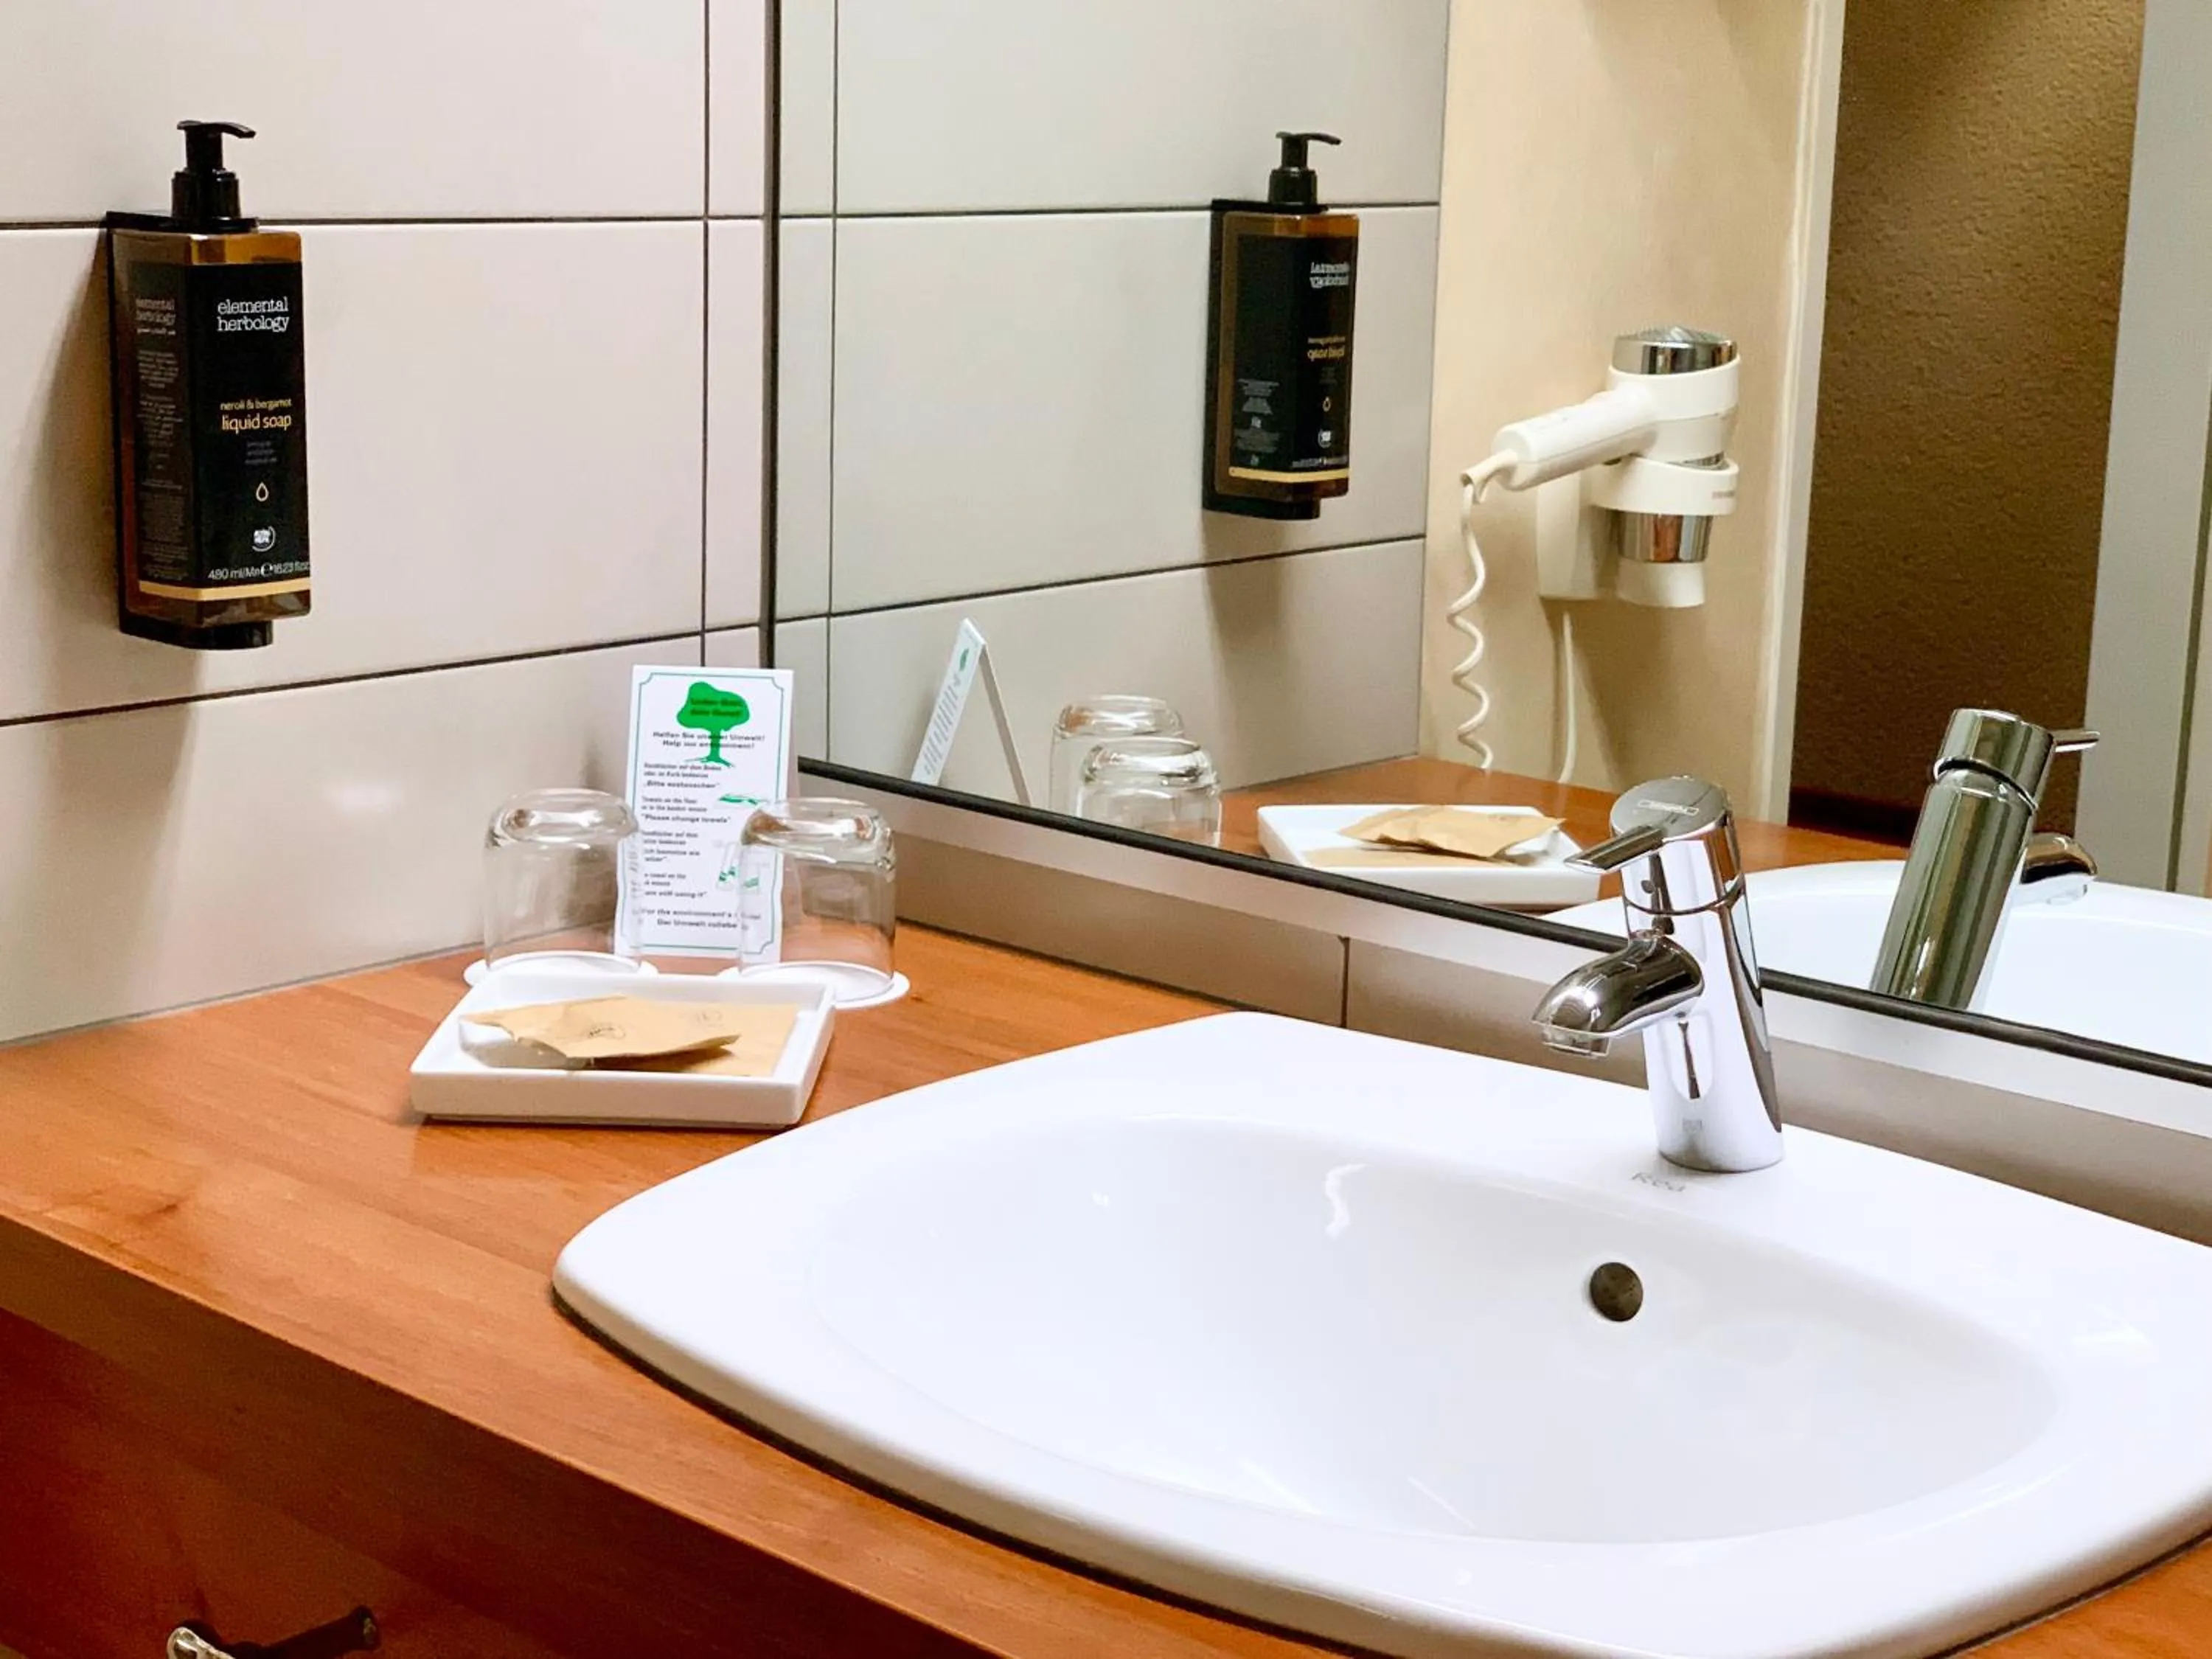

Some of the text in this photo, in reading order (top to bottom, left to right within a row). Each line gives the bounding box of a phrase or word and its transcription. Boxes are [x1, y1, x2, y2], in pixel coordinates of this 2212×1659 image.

[218, 296, 288, 315] elemental
[217, 316, 290, 333] herbology
[222, 412, 292, 435] liquid soap
